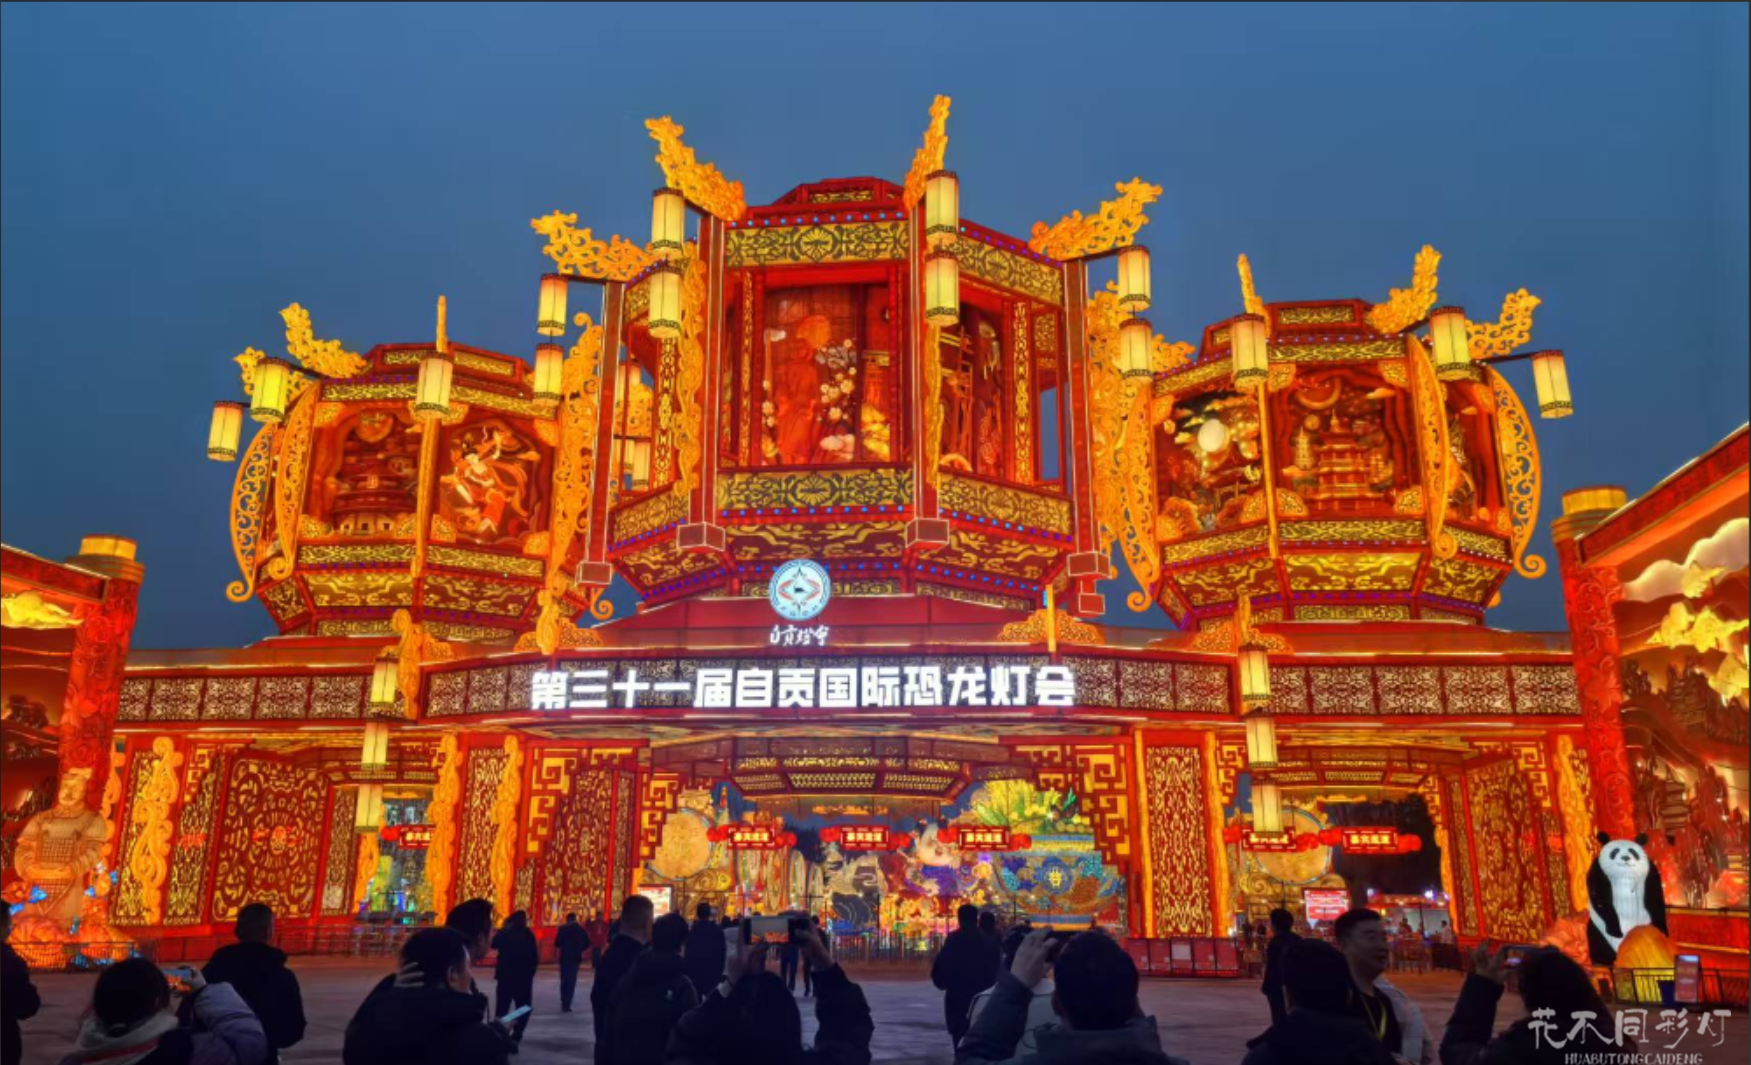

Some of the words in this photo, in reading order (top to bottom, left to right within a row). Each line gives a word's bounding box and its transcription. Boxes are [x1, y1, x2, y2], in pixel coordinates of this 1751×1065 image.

[531, 665, 1076, 710] 第三十一届自贡国际恐龙灯会
